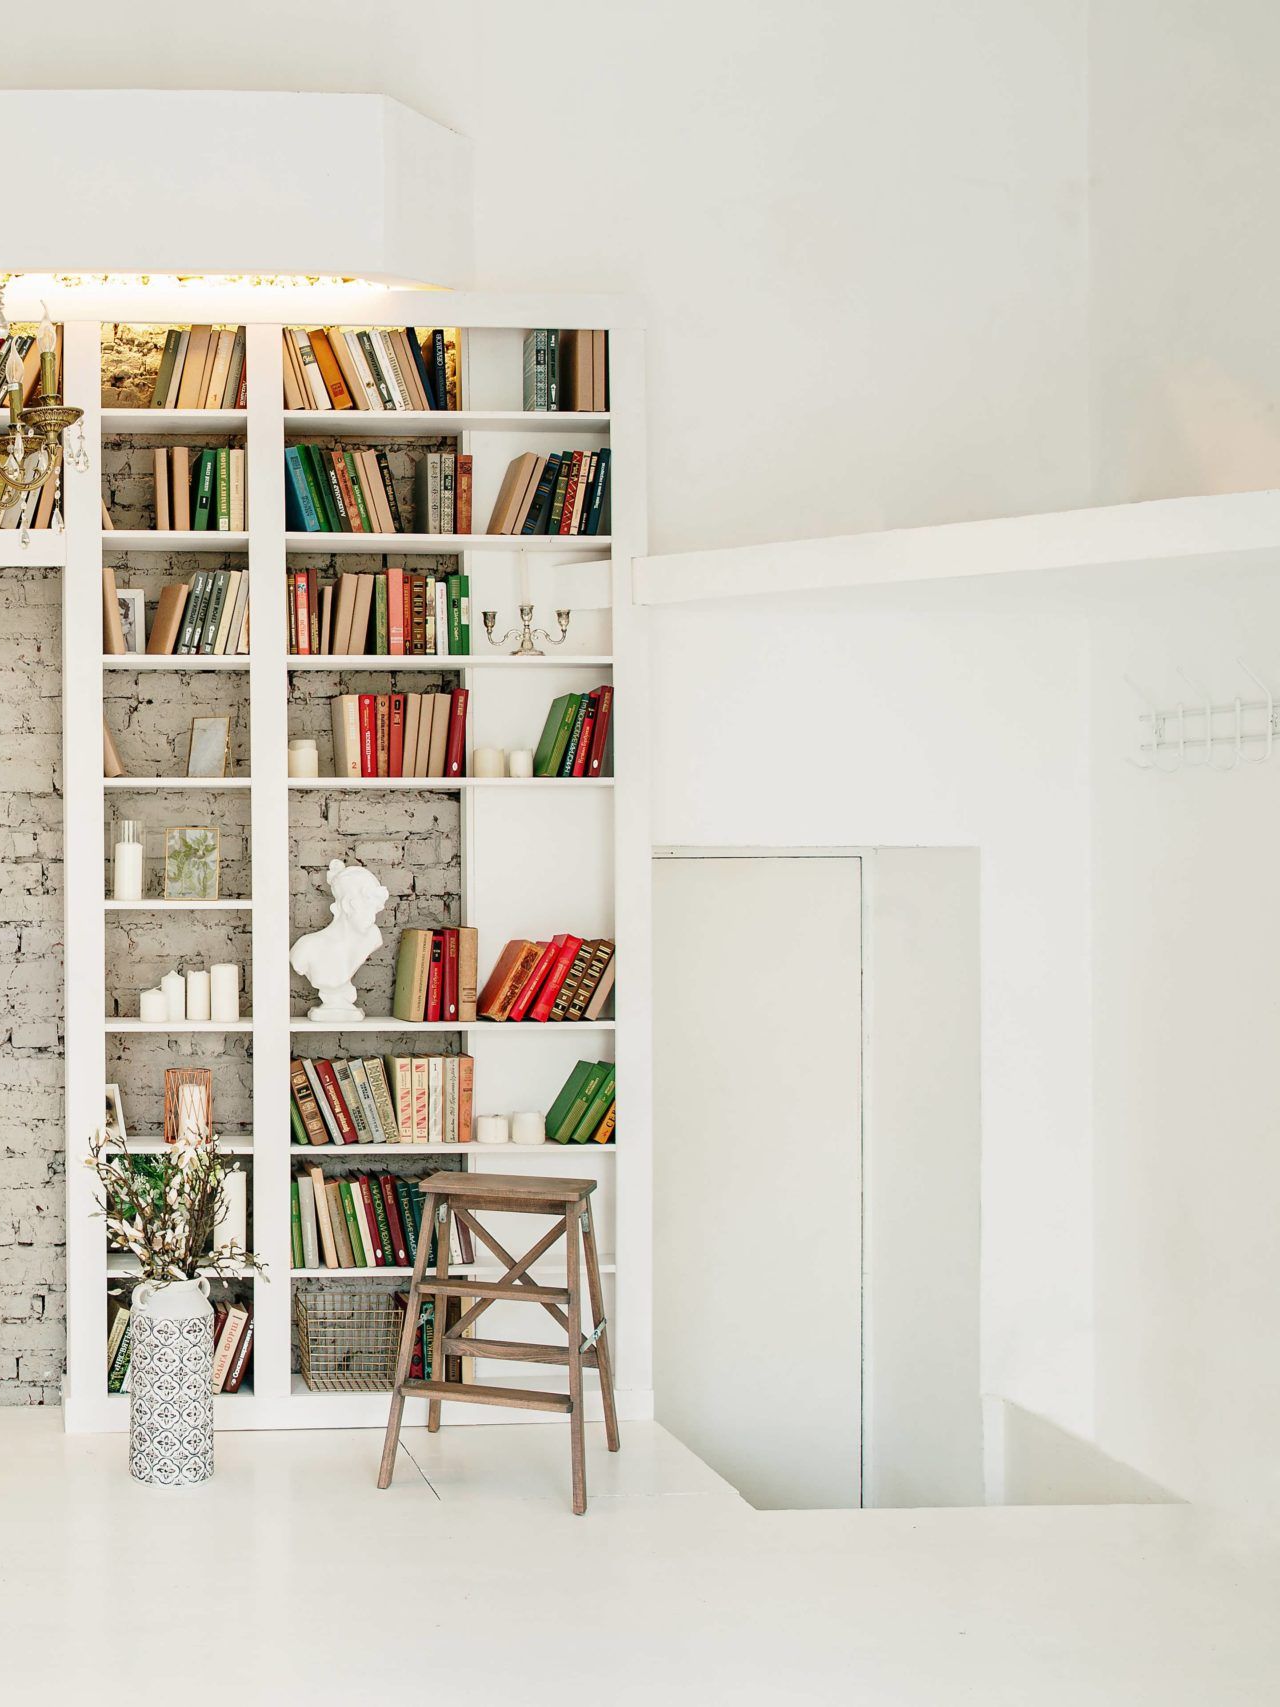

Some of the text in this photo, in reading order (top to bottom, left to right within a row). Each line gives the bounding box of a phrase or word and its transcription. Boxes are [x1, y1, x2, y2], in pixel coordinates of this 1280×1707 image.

[435, 333, 443, 366] ОБЛОМОВ
[332, 483, 346, 517] АЛЕКСАНДР
[572, 709, 585, 742] ЗАДОРНОВ
[370, 1184, 392, 1255] МИХАИЛ ЛУКОНИН
[214, 1321, 238, 1379] ОЛЬГА ФОРШ
